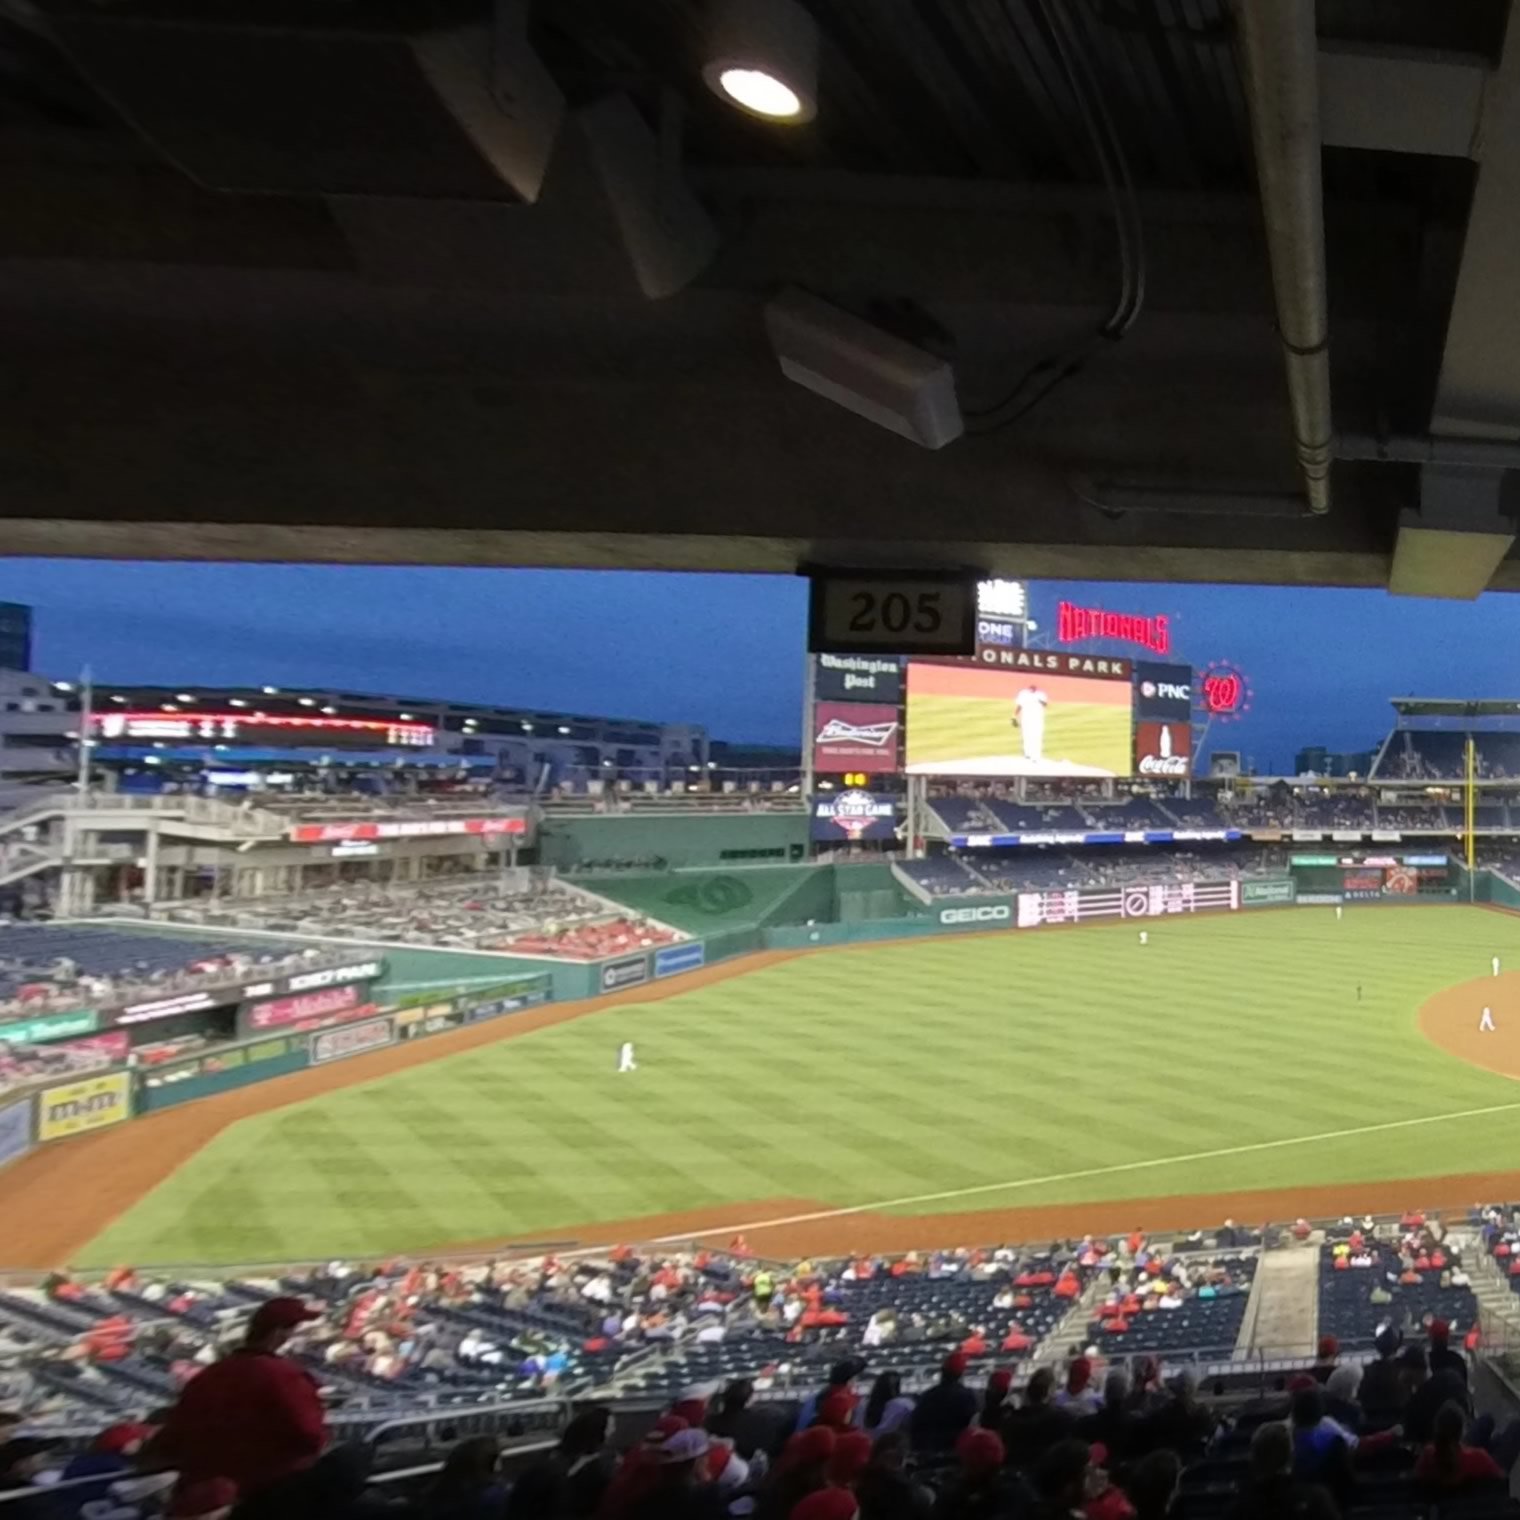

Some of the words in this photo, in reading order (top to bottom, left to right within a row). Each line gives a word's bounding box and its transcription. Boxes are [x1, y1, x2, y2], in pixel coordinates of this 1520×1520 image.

[849, 592, 941, 633] 205
[977, 621, 1013, 638] ONE
[1059, 600, 1169, 655] NATIONALS
[820, 653, 898, 674] Washington
[957, 649, 1059, 669] ONALS
[1068, 656, 1123, 675] PARK
[844, 674, 876, 690] Post
[1157, 683, 1191, 700] PNC
[816, 803, 836, 817] ALL
[837, 803, 864, 817] STAR
[865, 803, 894, 817] GAME
[940, 905, 1009, 924] GEICO
